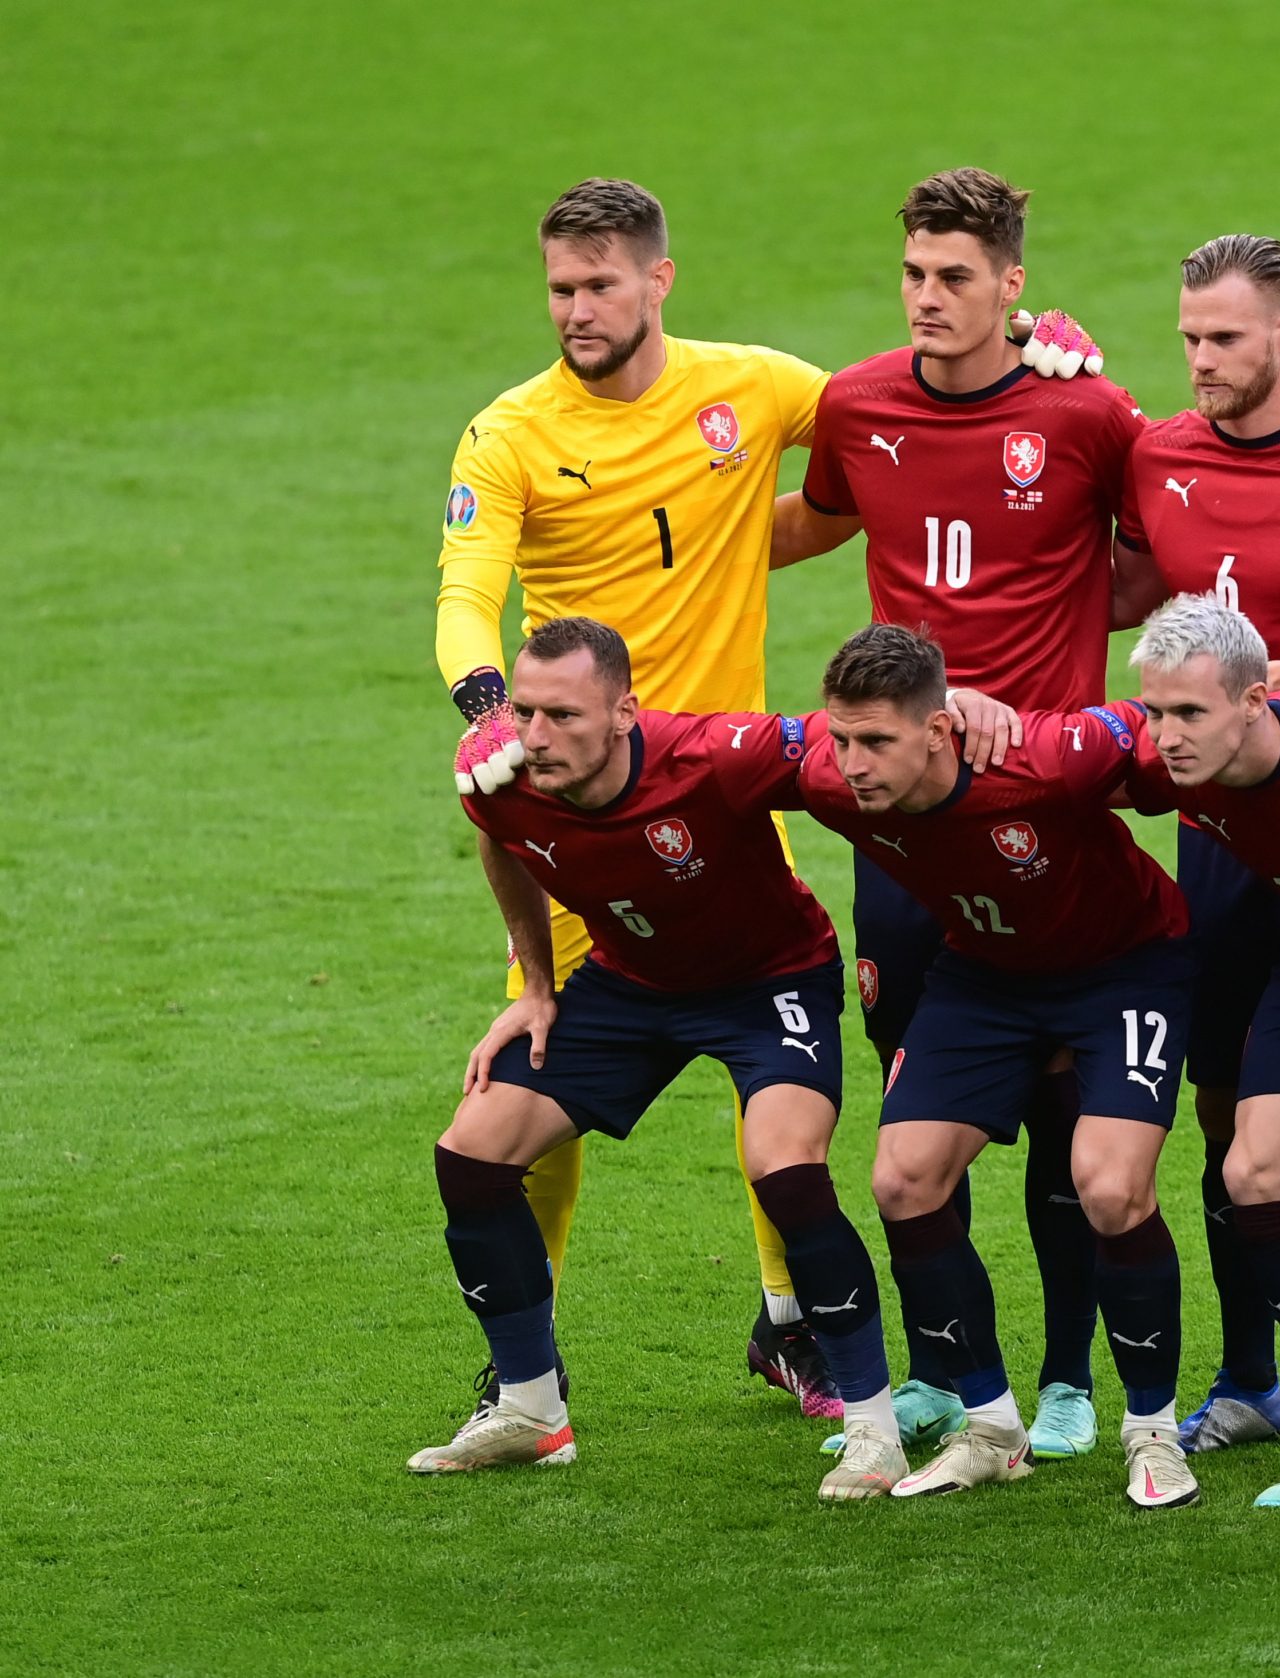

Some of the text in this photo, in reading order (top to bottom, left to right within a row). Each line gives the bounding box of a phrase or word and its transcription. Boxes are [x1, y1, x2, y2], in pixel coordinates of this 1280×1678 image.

[652, 507, 673, 569] 1
[923, 516, 972, 589] 10
[1215, 554, 1239, 613] 6
[607, 899, 655, 938] 5
[951, 894, 1017, 934] 12
[773, 991, 811, 1034] 5
[1122, 1009, 1168, 1072] 12
